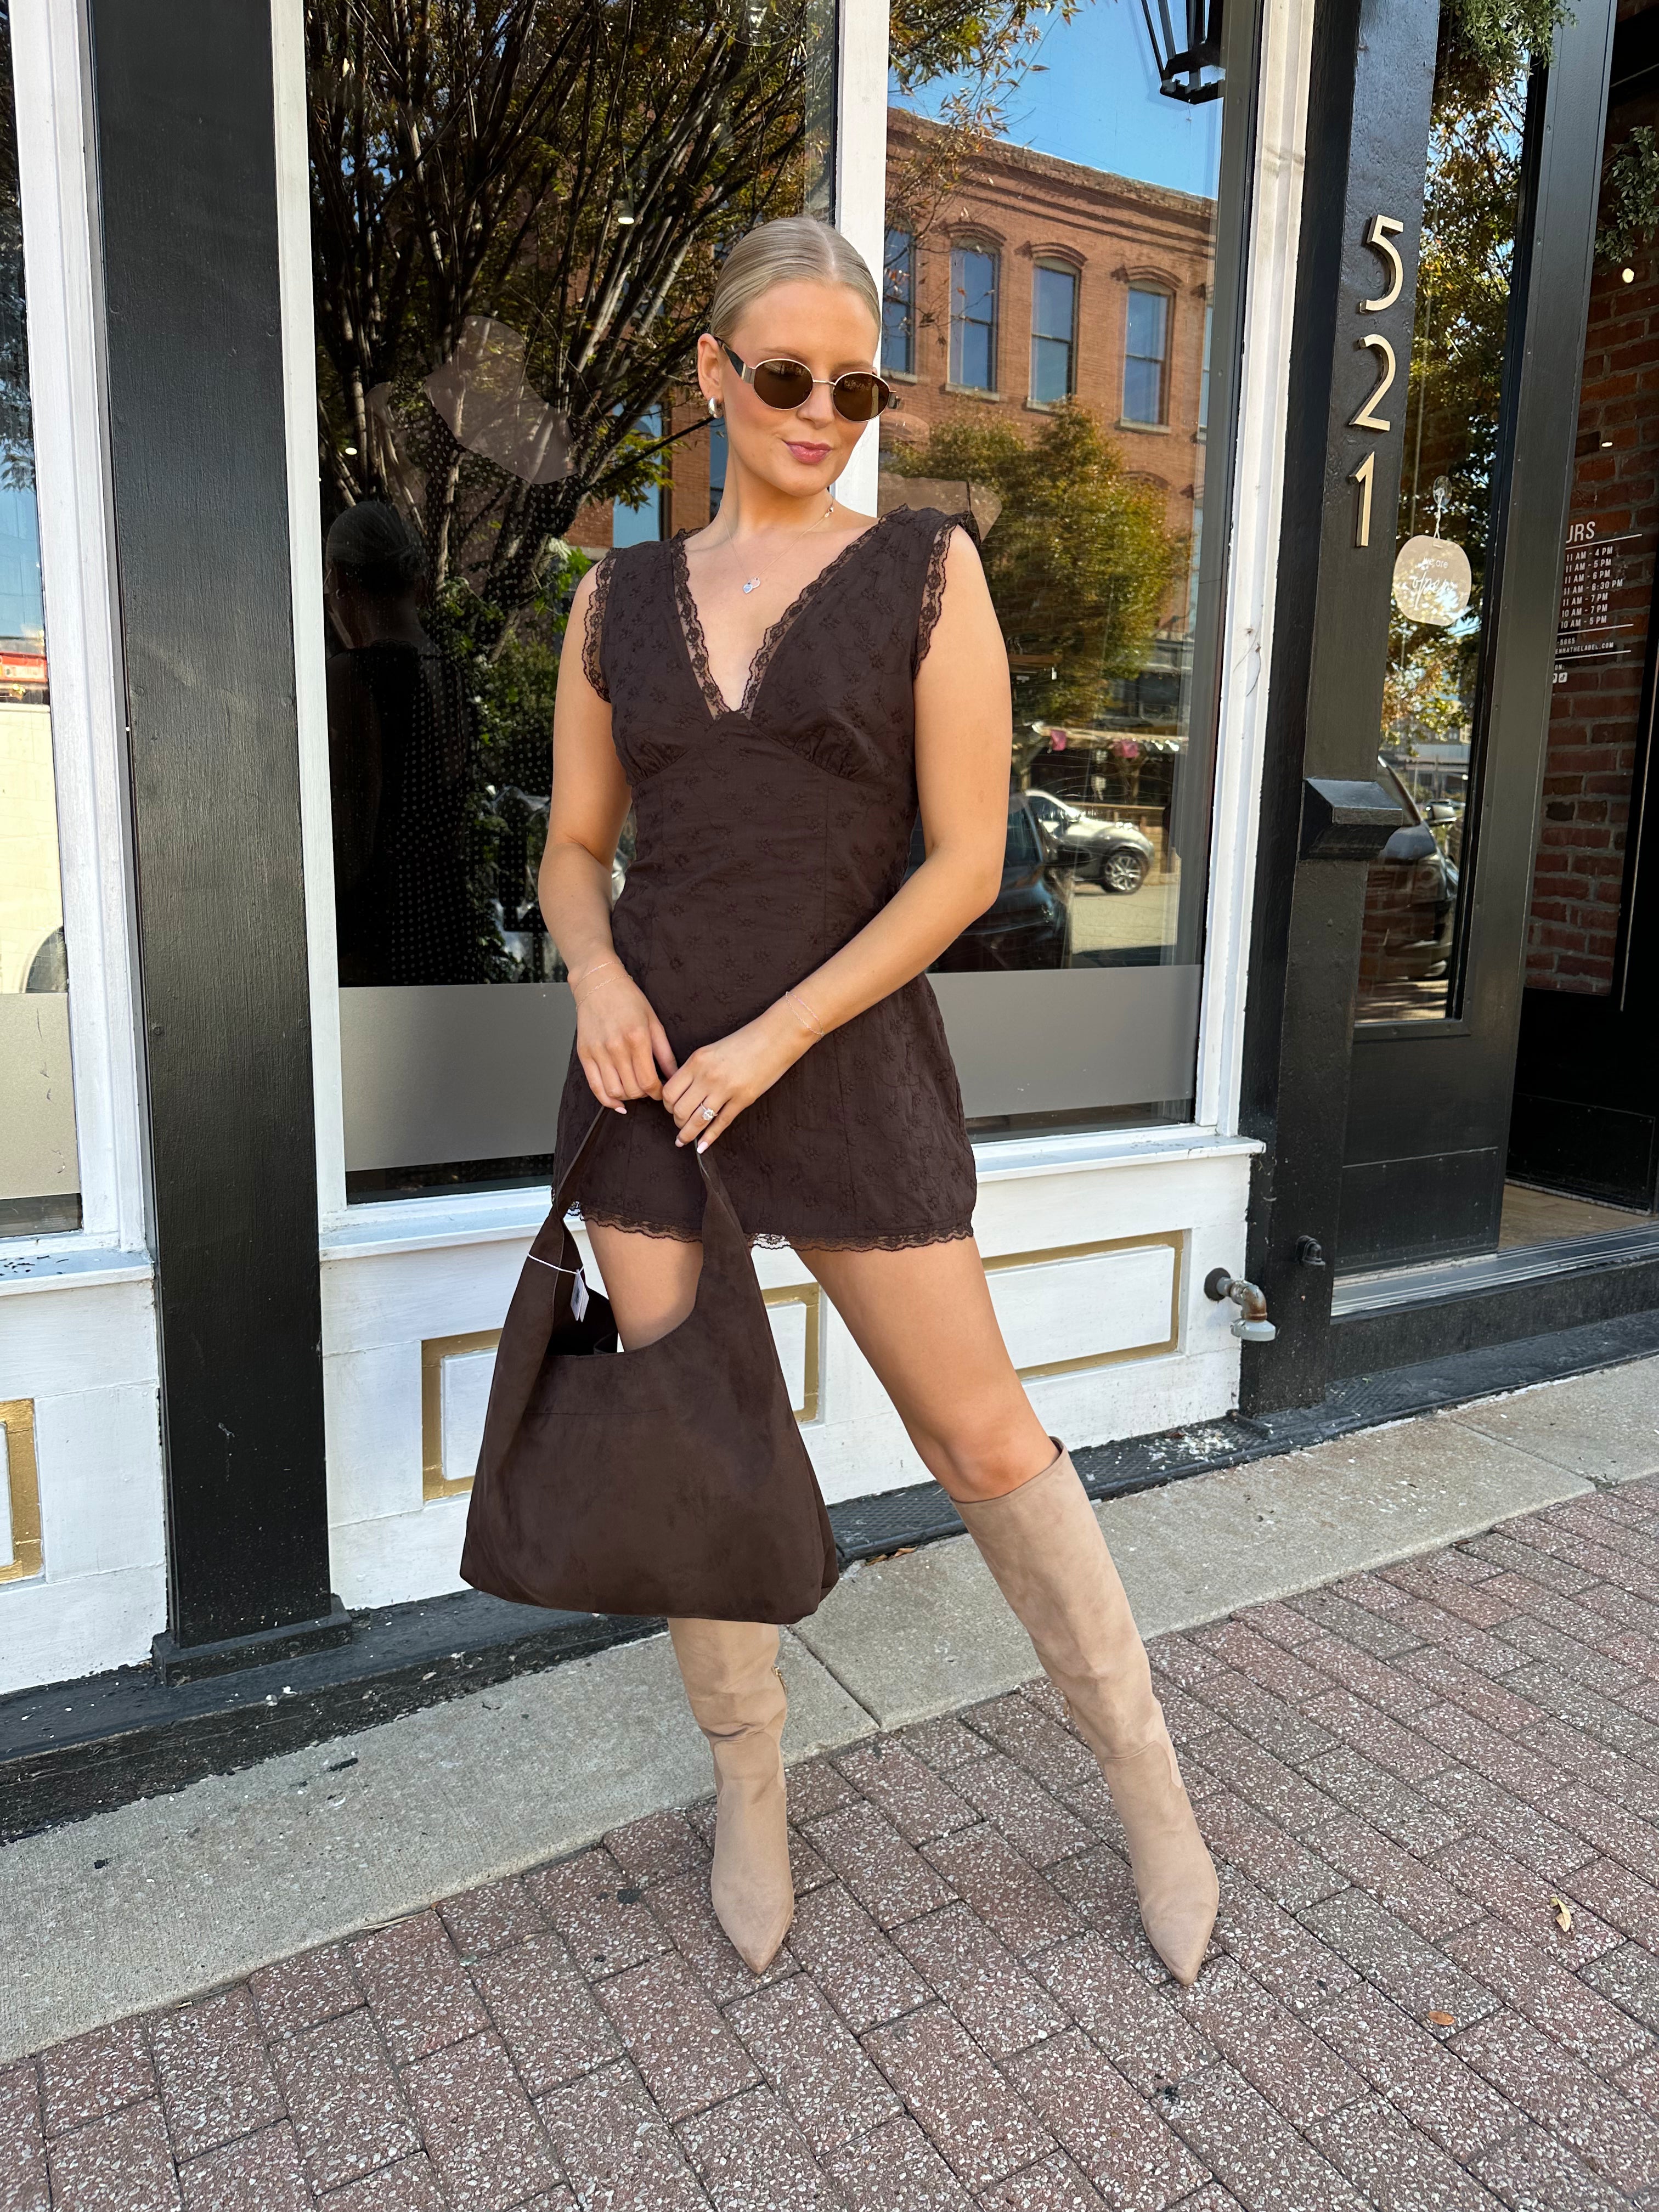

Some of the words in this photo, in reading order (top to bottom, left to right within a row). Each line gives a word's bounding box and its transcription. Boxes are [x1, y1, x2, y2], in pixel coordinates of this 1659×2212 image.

[1348, 215, 1403, 548] 521
[1566, 554, 1573, 562] 11
[1575, 551, 1587, 560] AM
[1595, 548, 1600, 556] 4
[1602, 546, 1613, 556] PM
[1435, 560, 1449, 569] are
[1566, 565, 1572, 573] 11
[1574, 562, 1585, 572] AM
[1594, 560, 1598, 568] 5
[1600, 558, 1611, 567] PM
[1565, 575, 1571, 584] 11
[1573, 573, 1584, 583] AM
[1593, 571, 1597, 579] 6
[1599, 569, 1611, 579] PM
[1564, 587, 1570, 595] 11
[1572, 585, 1583, 594] AM
[1592, 581, 1610, 591] 6:30
[1612, 579, 1623, 588] PM
[1562, 599, 1569, 607] 11
[1571, 596, 1582, 606] AM
[1591, 594, 1595, 602] 7
[1597, 592, 1608, 602] PM
[1562, 610, 1569, 618] 10
[1571, 607, 1582, 617] AM
[1590, 606, 1595, 614] 7
[1596, 603, 1608, 613] PM
[1561, 620, 1568, 629] 10
[1570, 618, 1581, 628] AM
[1589, 617, 1594, 625] 5
[1596, 615, 1607, 624] PM
